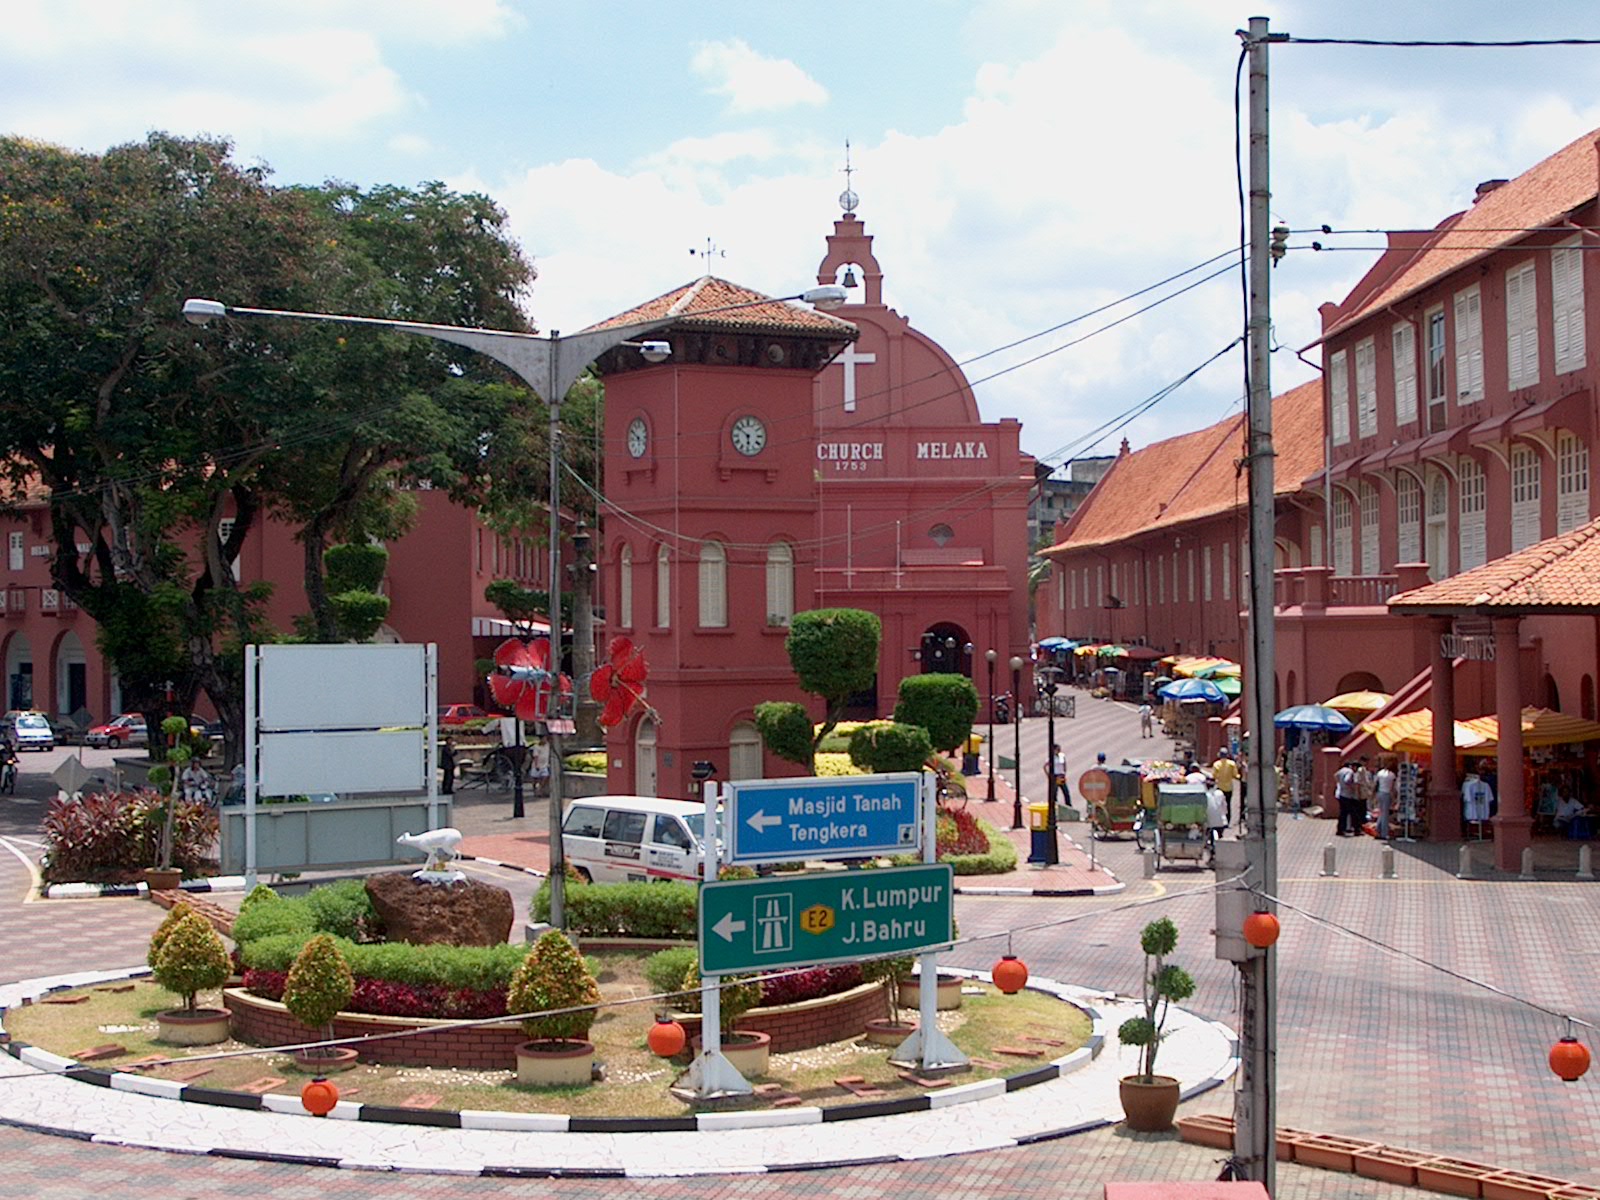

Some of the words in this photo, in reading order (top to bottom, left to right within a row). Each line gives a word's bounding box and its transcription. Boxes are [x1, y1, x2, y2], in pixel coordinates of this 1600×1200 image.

[817, 443, 883, 460] CHURCH
[917, 442, 988, 458] MELAKA
[835, 462, 867, 471] 1753
[788, 796, 846, 818] Masjid
[853, 794, 901, 812] Tanah
[789, 823, 868, 843] Tengkera
[808, 909, 828, 928] E2
